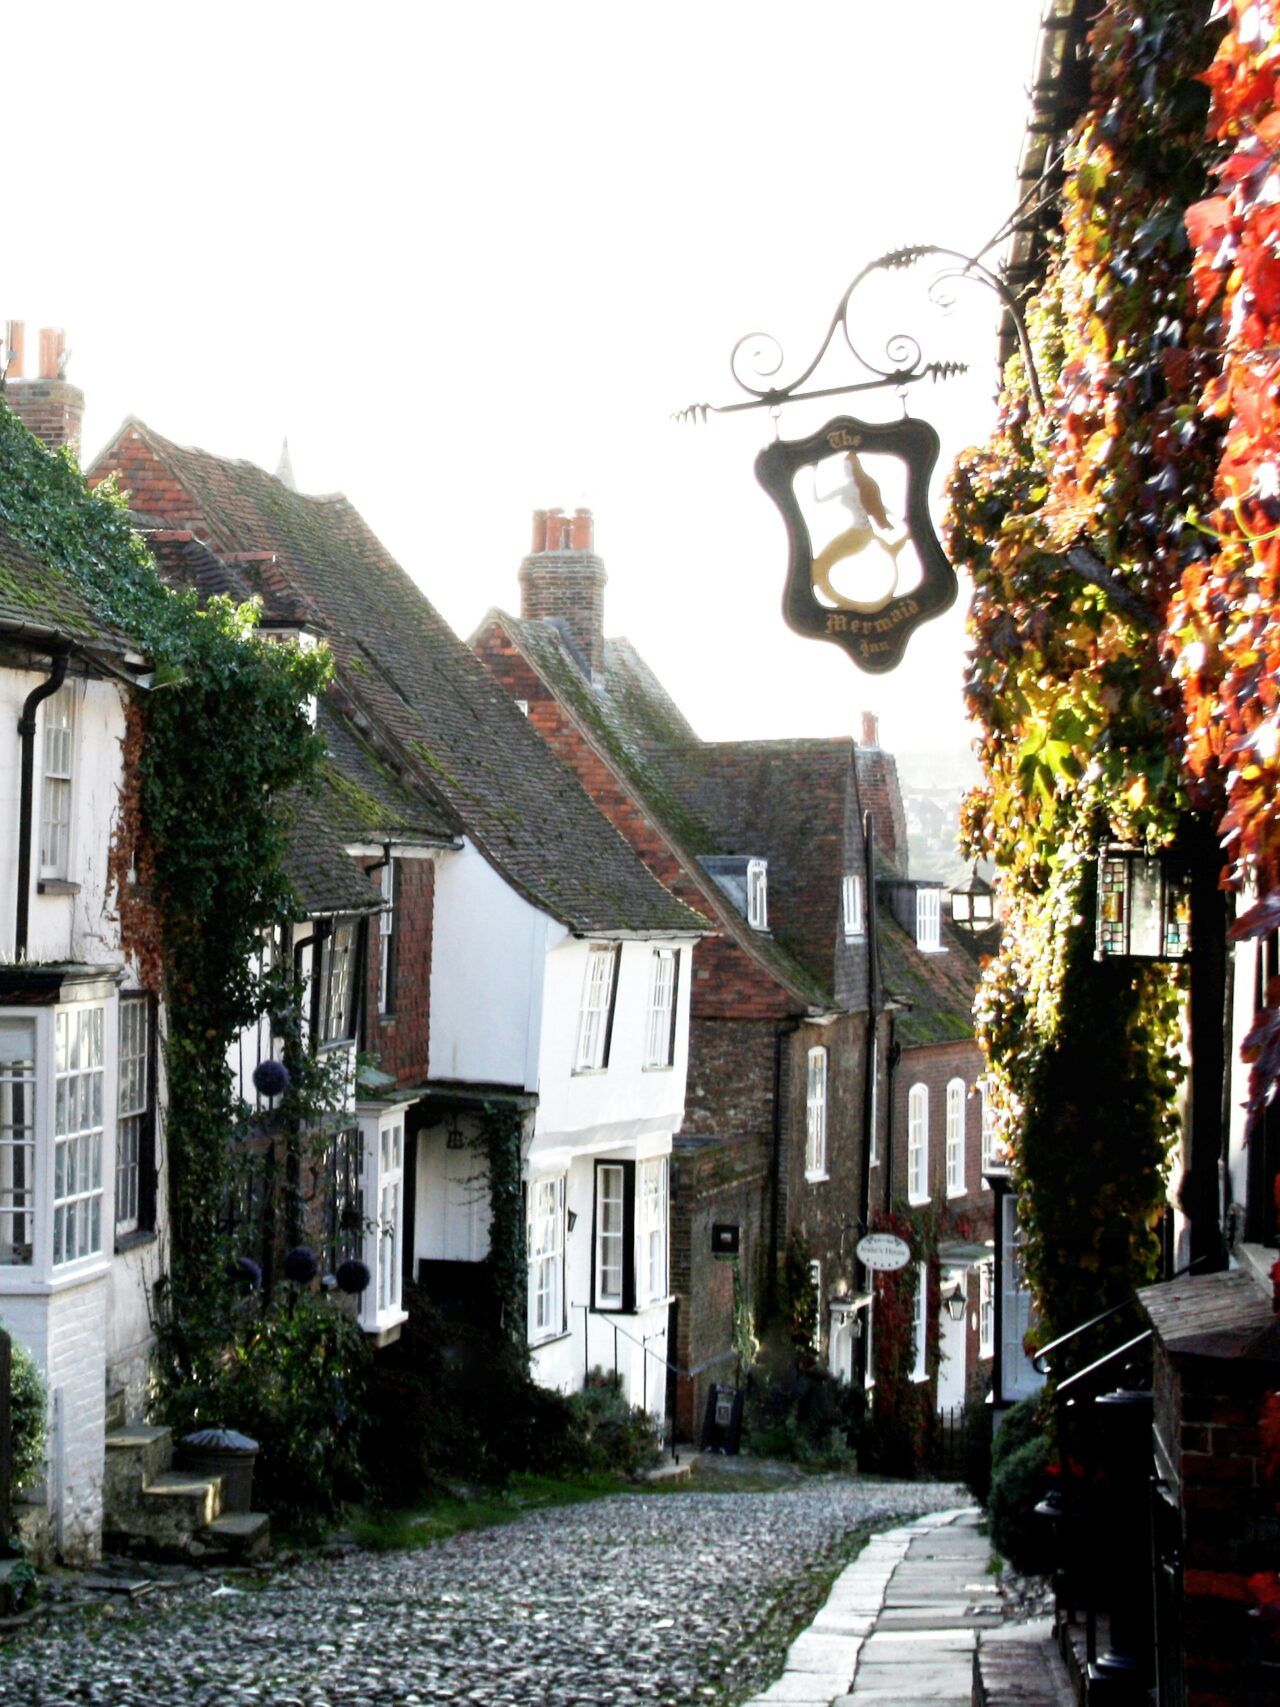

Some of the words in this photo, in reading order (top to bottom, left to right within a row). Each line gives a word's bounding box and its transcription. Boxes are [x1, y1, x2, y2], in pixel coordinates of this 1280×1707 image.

[827, 429, 862, 448] The
[825, 599, 919, 634] Mermaid
[860, 640, 890, 657] Inn
